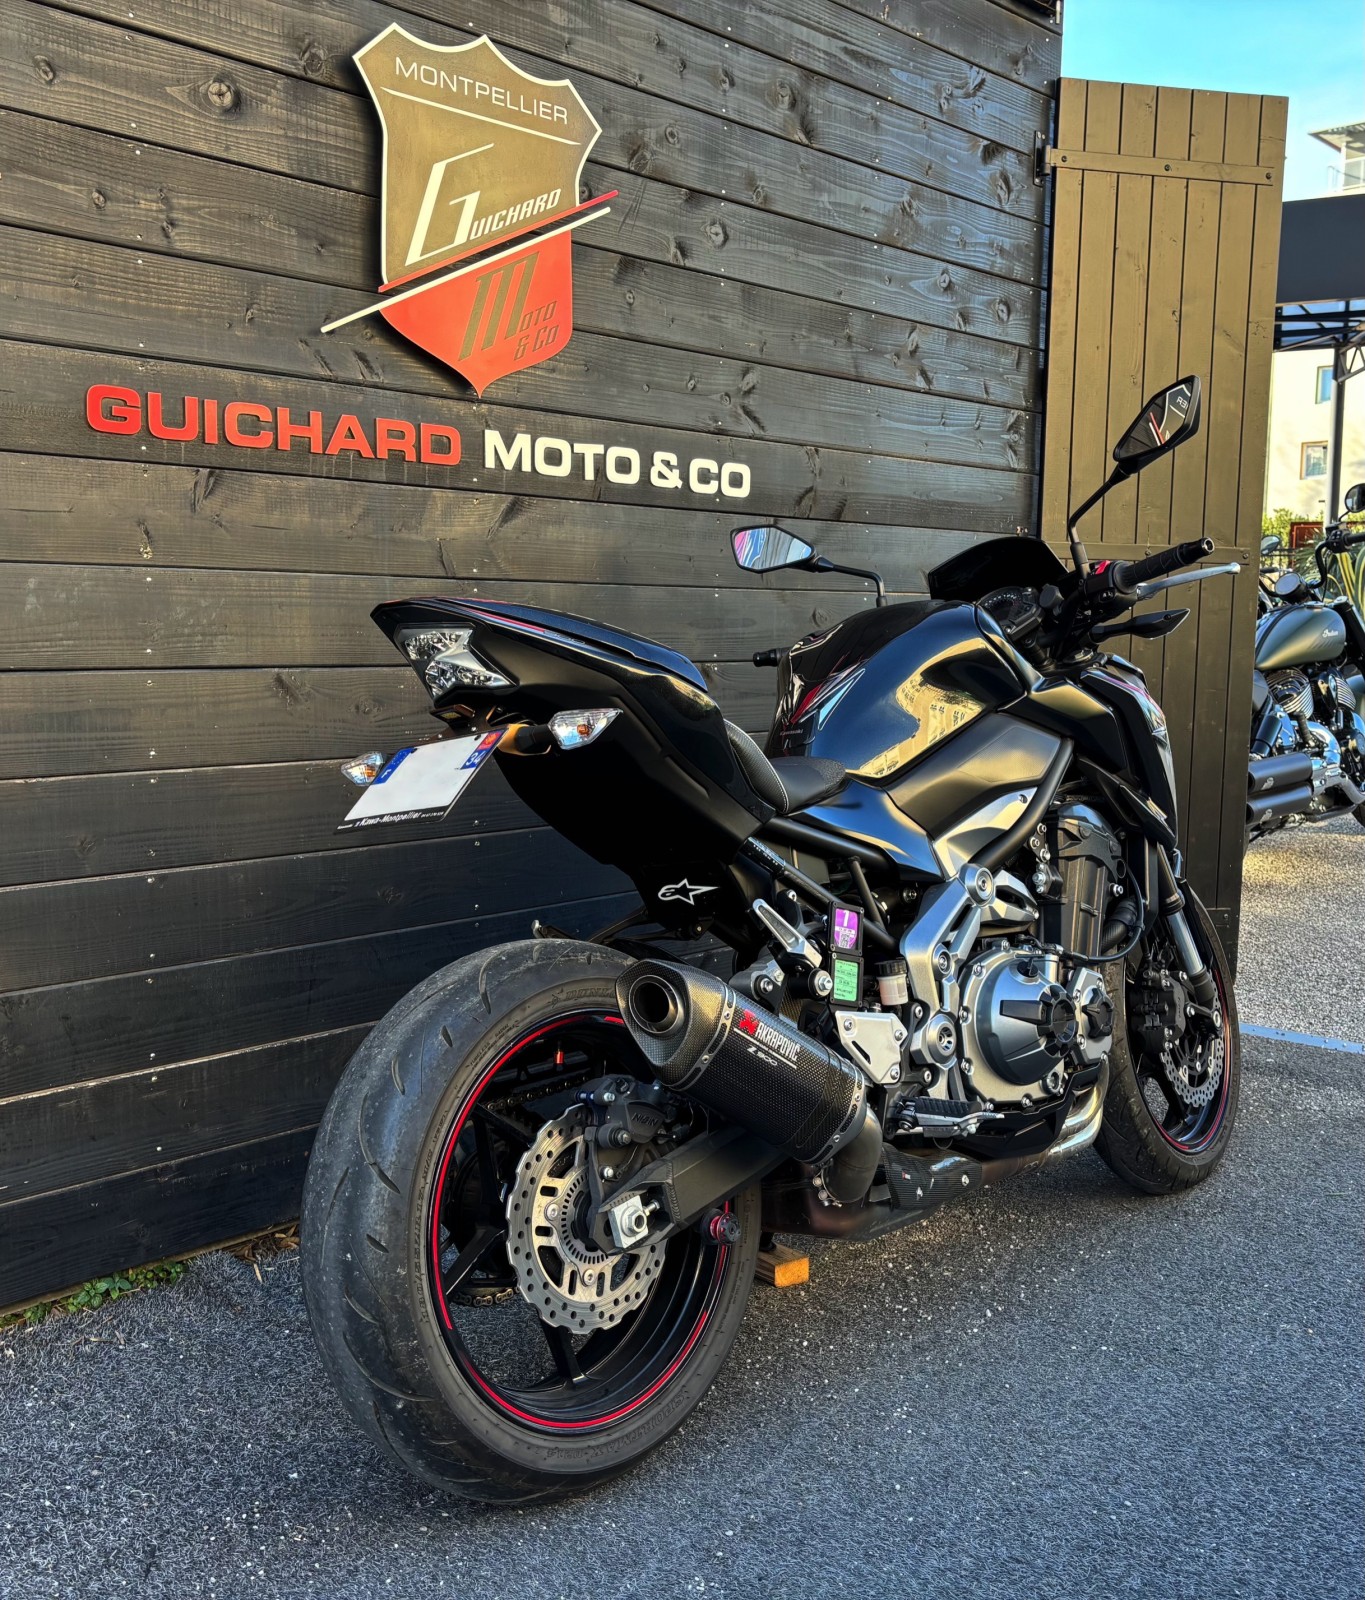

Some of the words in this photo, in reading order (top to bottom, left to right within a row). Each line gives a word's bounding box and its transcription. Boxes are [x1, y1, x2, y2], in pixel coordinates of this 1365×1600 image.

[395, 57, 568, 125] MONTPELLIER
[513, 334, 530, 361] &
[86, 383, 463, 466] GUICHARD
[484, 430, 641, 485] MOTO
[650, 458, 683, 489] &
[689, 459, 752, 498] CO
